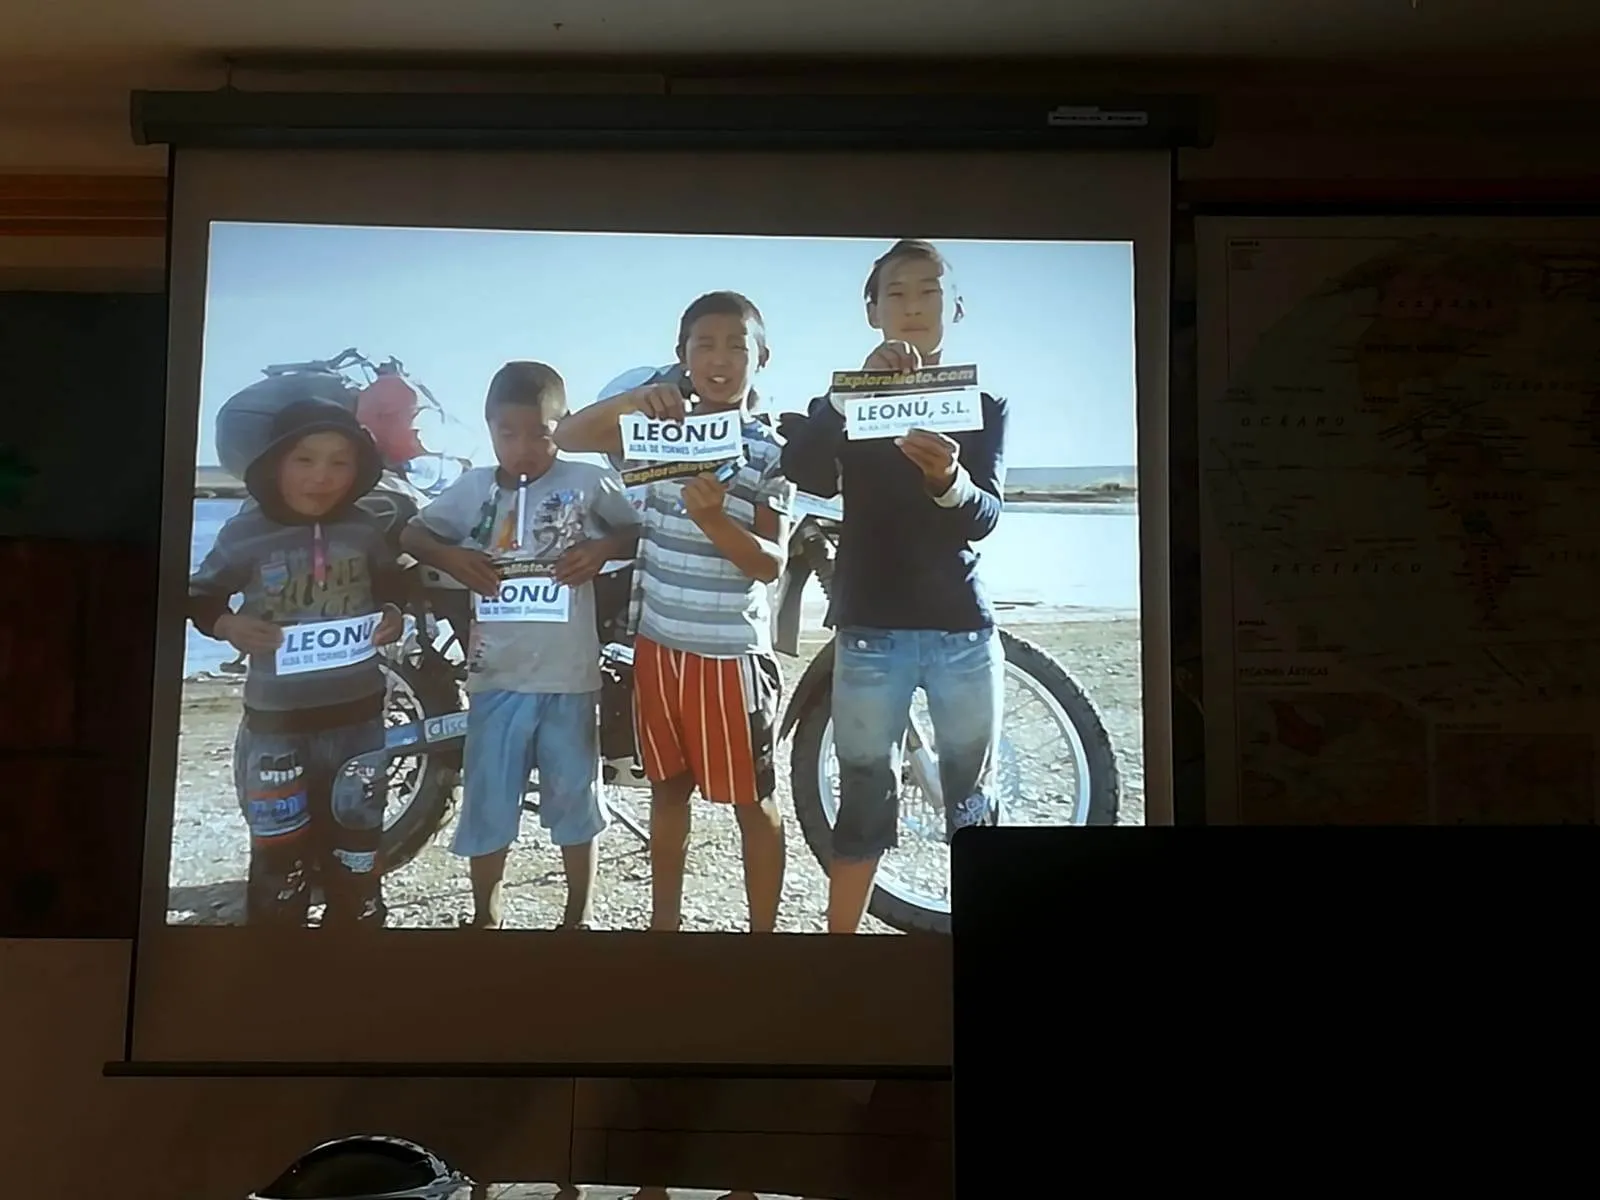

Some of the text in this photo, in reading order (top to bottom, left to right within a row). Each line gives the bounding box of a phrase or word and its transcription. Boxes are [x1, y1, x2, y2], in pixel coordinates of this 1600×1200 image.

[857, 397, 971, 421] LEONÚ, S.L.
[632, 417, 729, 443] LEONÚ
